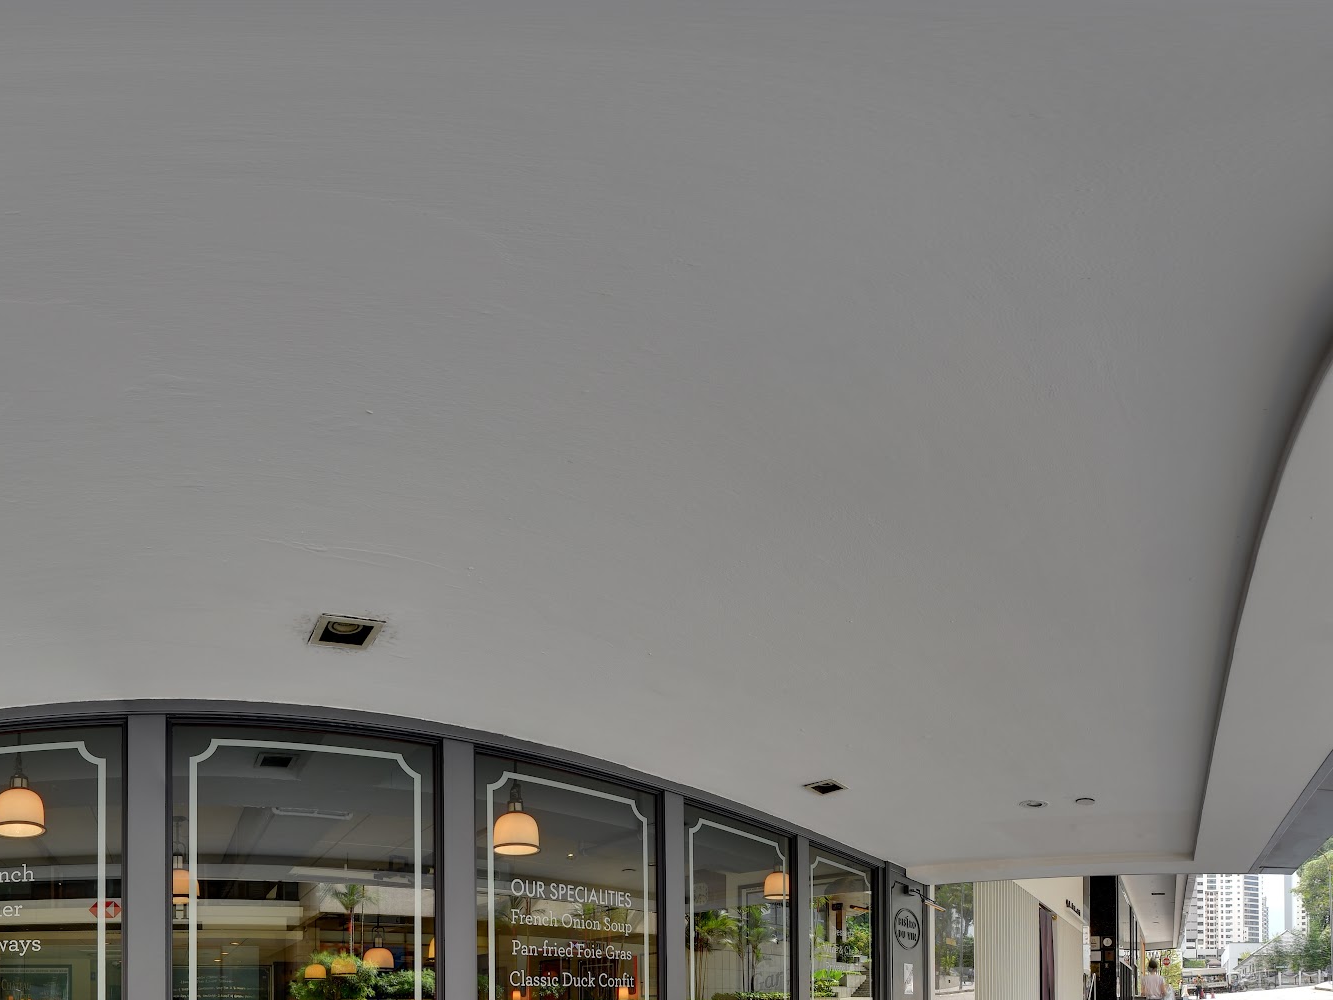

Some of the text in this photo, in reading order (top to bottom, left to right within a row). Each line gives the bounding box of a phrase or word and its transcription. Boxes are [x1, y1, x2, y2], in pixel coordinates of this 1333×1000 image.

[511, 878, 632, 908] OUR SPECIALITIES
[511, 908, 633, 937] French Onion Soup
[511, 939, 633, 961] Pan-fried Foie Gras
[509, 969, 635, 988] Classic Duck Confit
